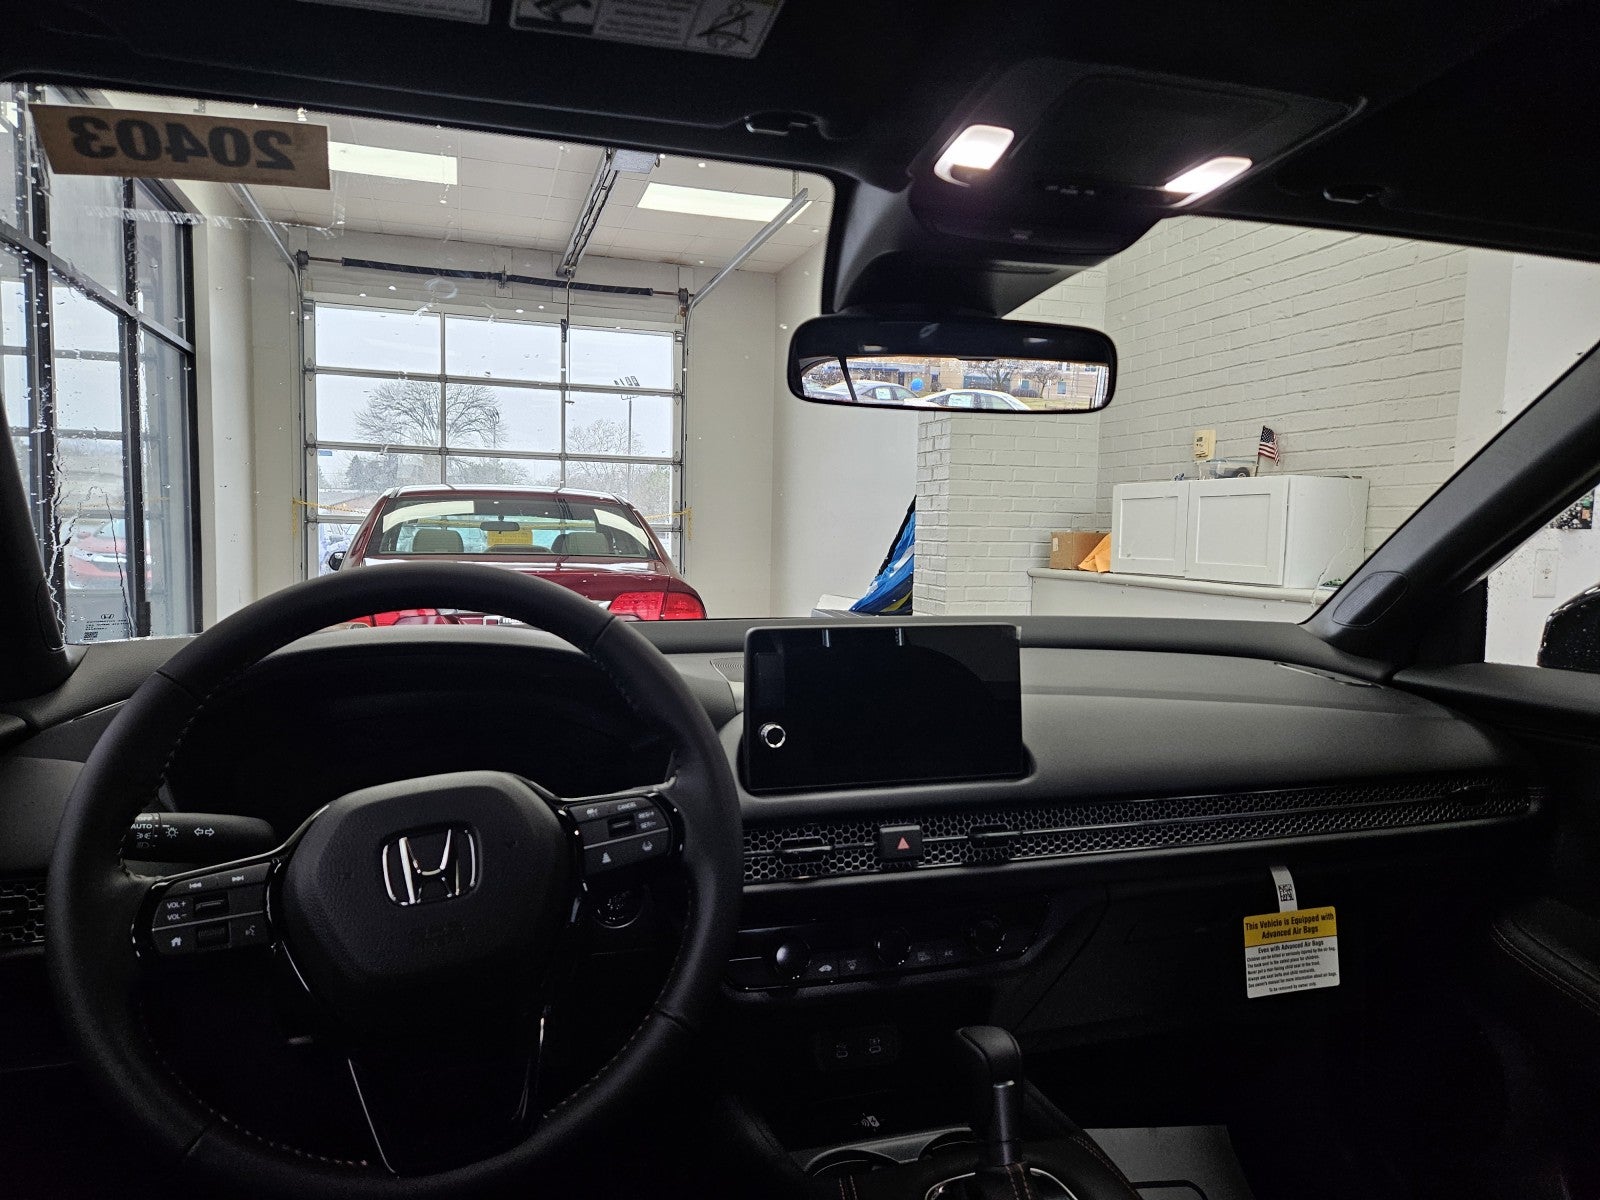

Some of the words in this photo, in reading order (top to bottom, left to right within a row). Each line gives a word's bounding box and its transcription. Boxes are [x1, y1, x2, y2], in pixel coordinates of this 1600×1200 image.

[1246, 922, 1258, 930] This
[1260, 919, 1282, 928] Vehicle
[1291, 914, 1320, 926] Equipped
[1321, 912, 1334, 921] with
[1262, 928, 1291, 939] Advanced
[1293, 927, 1302, 935] Air
[1303, 925, 1318, 935] Bags
